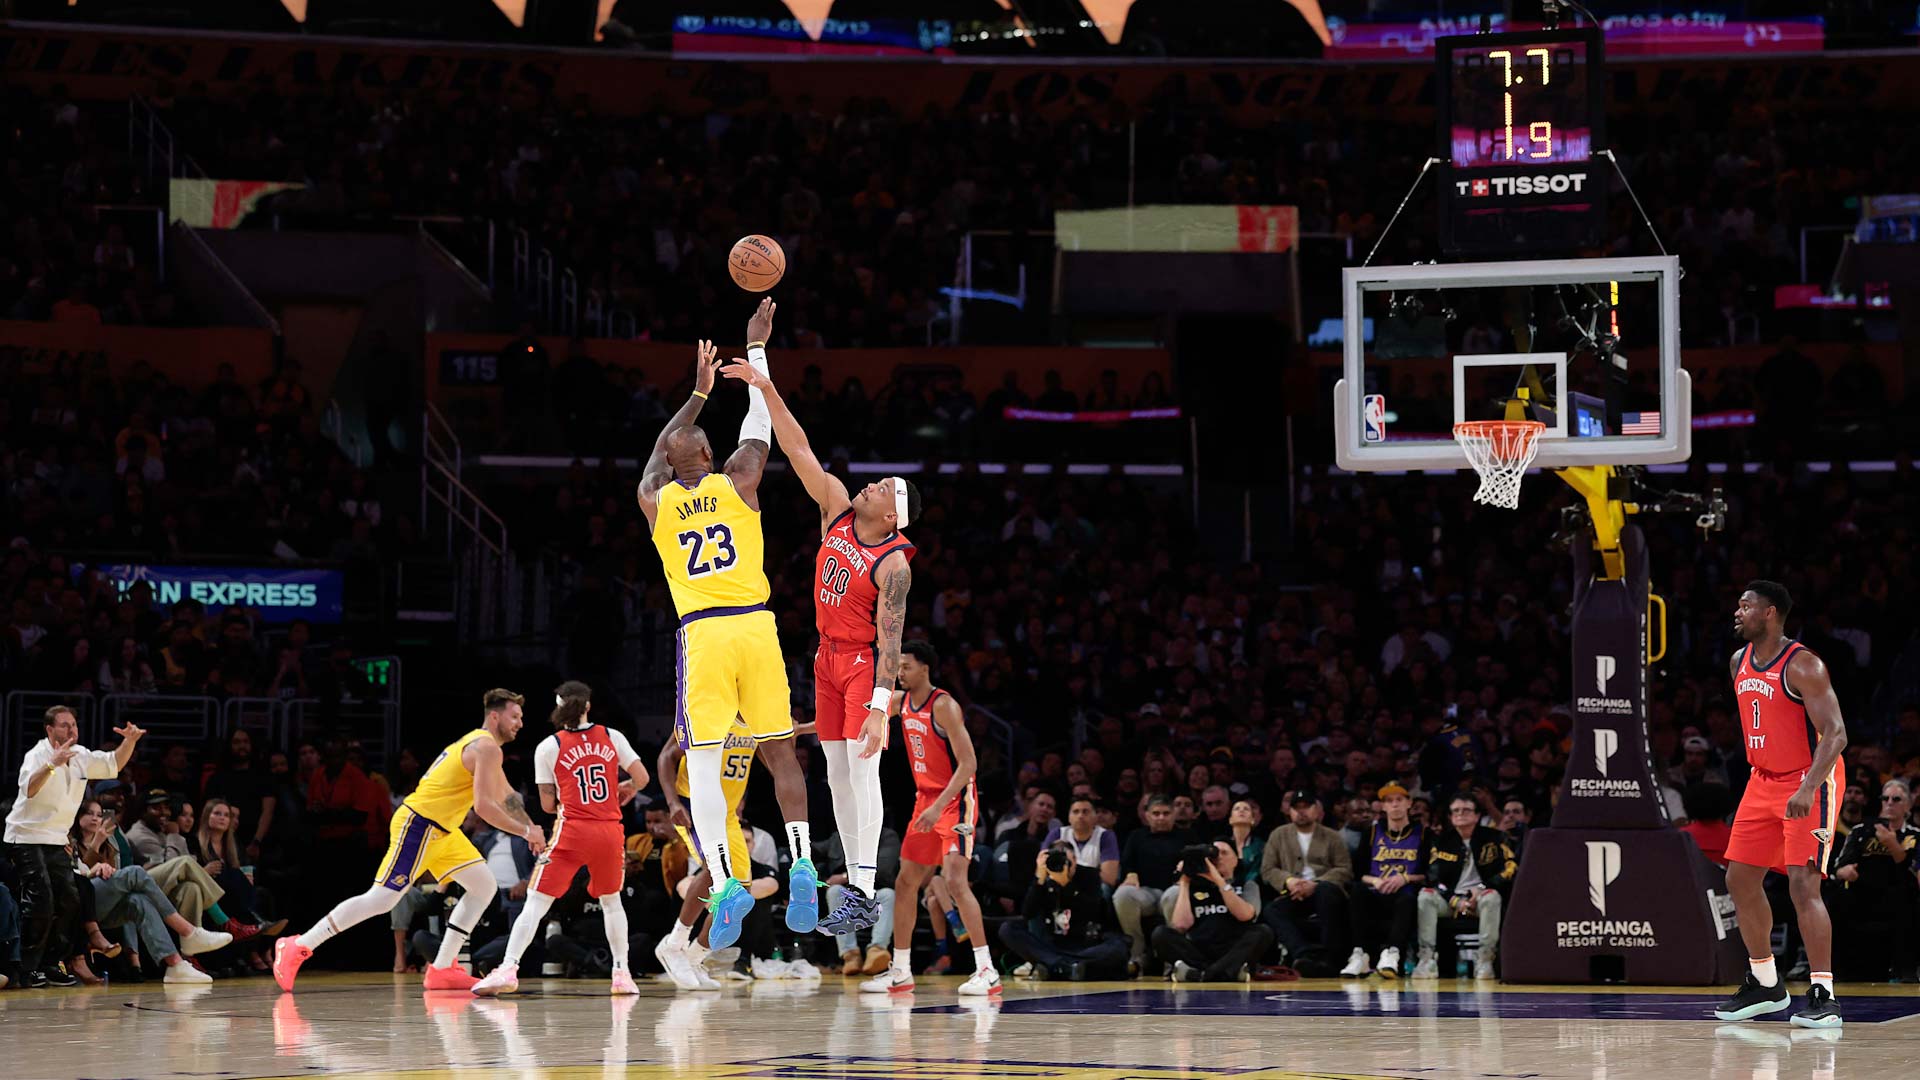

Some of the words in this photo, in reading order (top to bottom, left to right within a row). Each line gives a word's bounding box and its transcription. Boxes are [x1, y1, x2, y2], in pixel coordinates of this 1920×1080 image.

[1489, 48, 1550, 88] 7.7
[1504, 91, 1552, 160] 1.9
[1491, 173, 1588, 197] TISSOT
[452, 355, 497, 382] 115
[676, 496, 718, 521] JAMES
[677, 522, 739, 581] 23
[825, 536, 868, 577] CRESCENT
[821, 555, 851, 596] 00
[190, 580, 318, 607] EXPRESS
[819, 588, 843, 608] CITY
[1737, 678, 1775, 700] CRESCENT
[1577, 697, 1633, 708] PECHANGA
[1751, 698, 1761, 730] 1
[723, 733, 757, 750] LAKER
[1748, 734, 1766, 750] ITY
[559, 743, 616, 771] ALVARADO
[723, 755, 751, 780] 55
[572, 764, 610, 805] 15
[1571, 779, 1641, 791] PECHANGA
[1608, 791, 1642, 799] CASINO
[1194, 904, 1228, 919] PHO
[1556, 921, 1655, 937] PECHANGA
[1557, 936, 1604, 948] RESORT
[1609, 936, 1657, 948] CASINO
